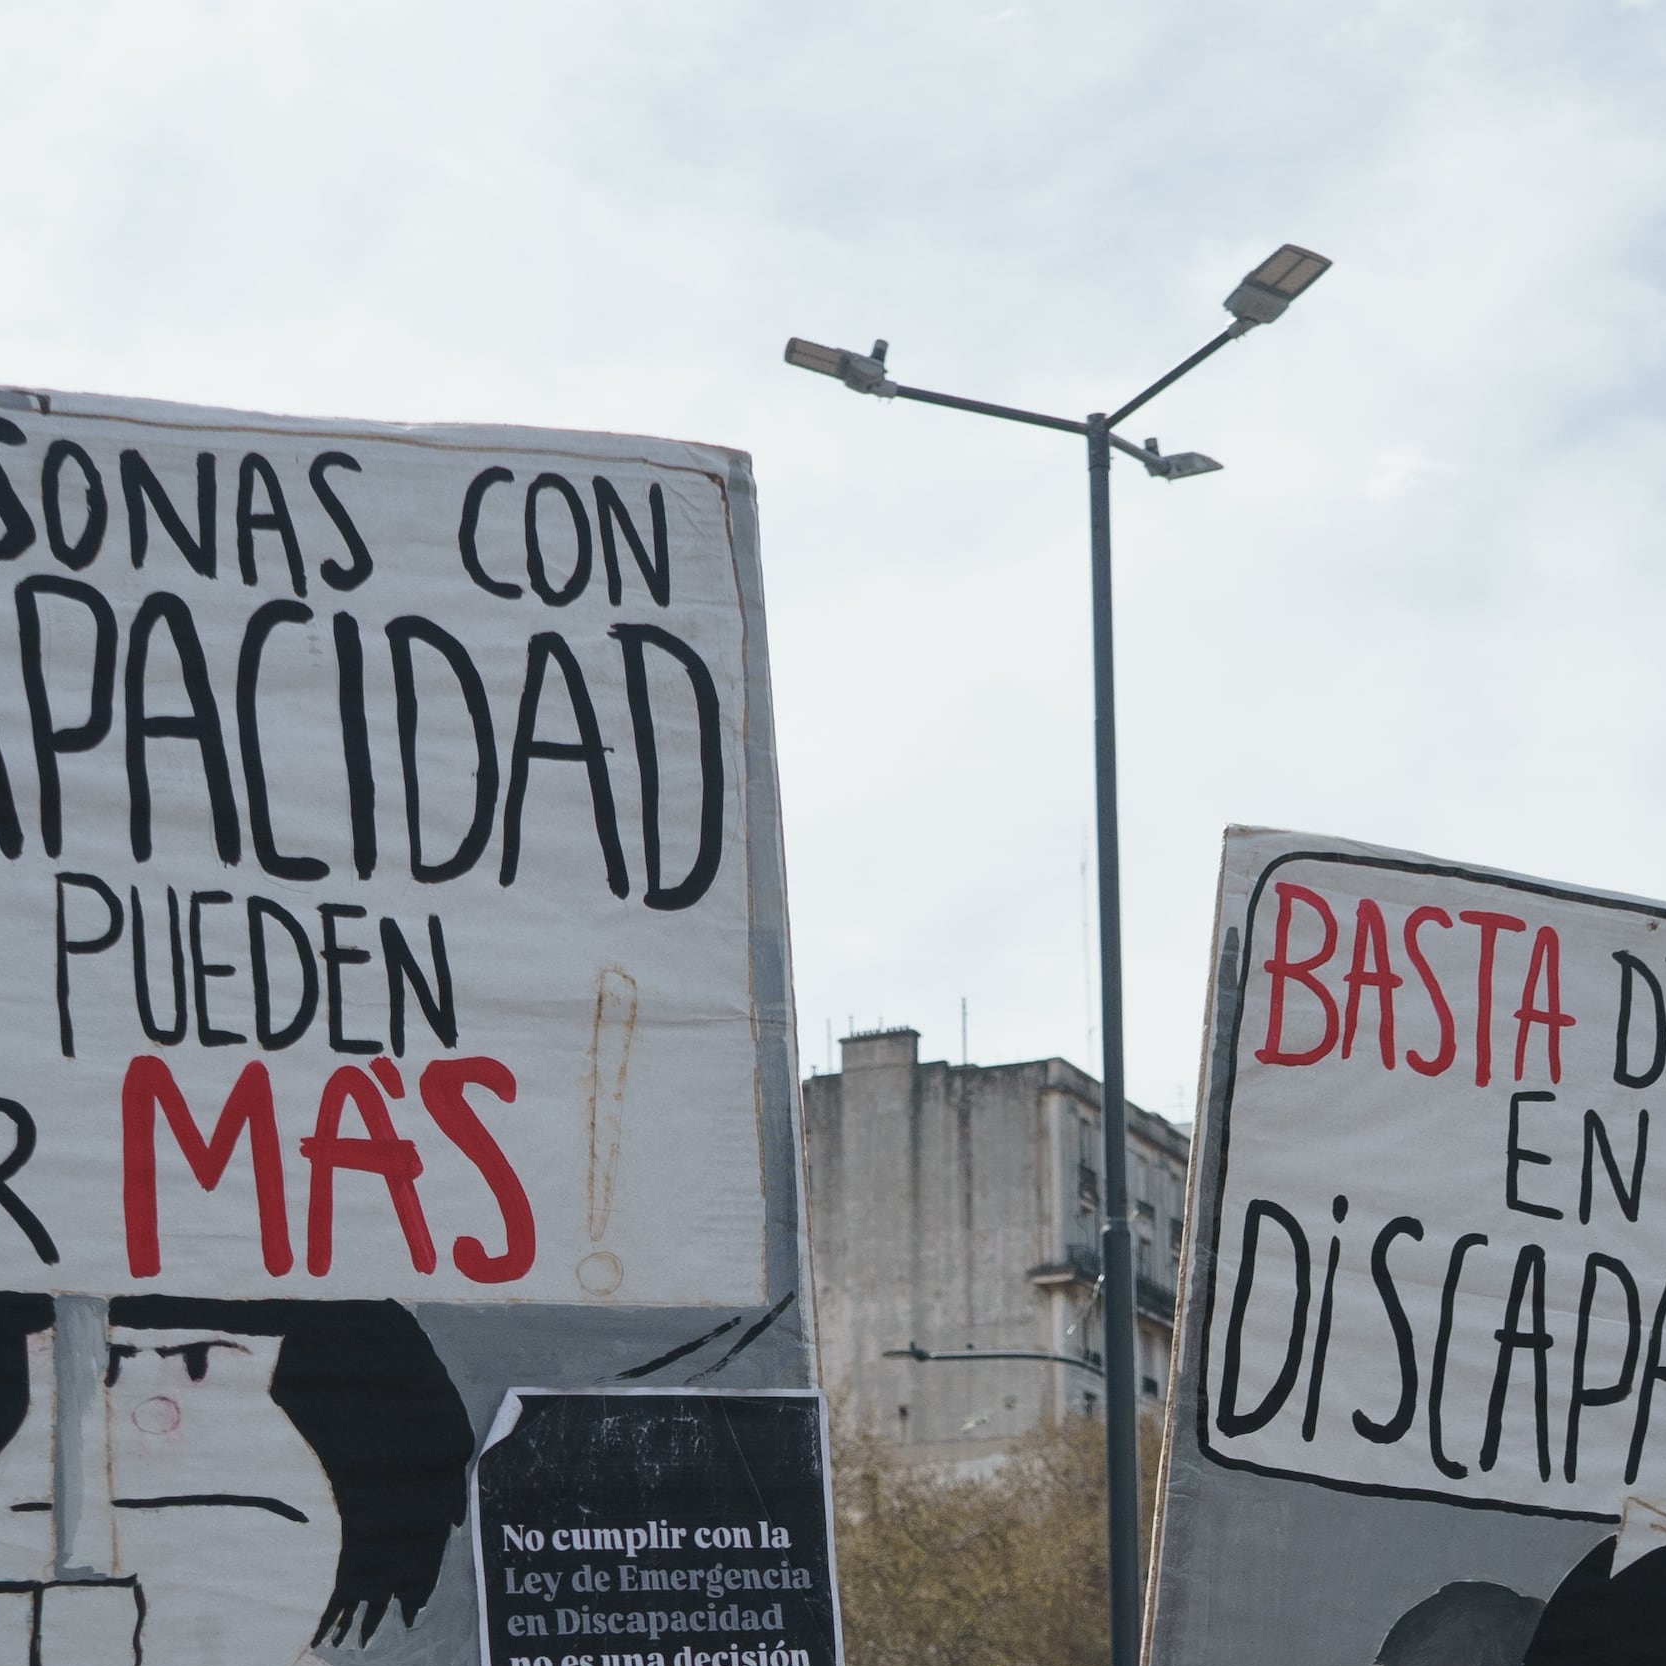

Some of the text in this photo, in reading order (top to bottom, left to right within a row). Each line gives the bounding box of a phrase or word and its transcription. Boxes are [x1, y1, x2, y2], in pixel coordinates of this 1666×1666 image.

[457, 464, 674, 609] CON
[55, 869, 459, 1059] PUEDEN
[1254, 880, 1577, 1089] BASTA
[1505, 1089, 1651, 1226] EN
[501, 1520, 793, 1558] No cumplir con la
[504, 1561, 814, 1602] Ley de Emergencia
[507, 1602, 786, 1643] en Discapacidad
